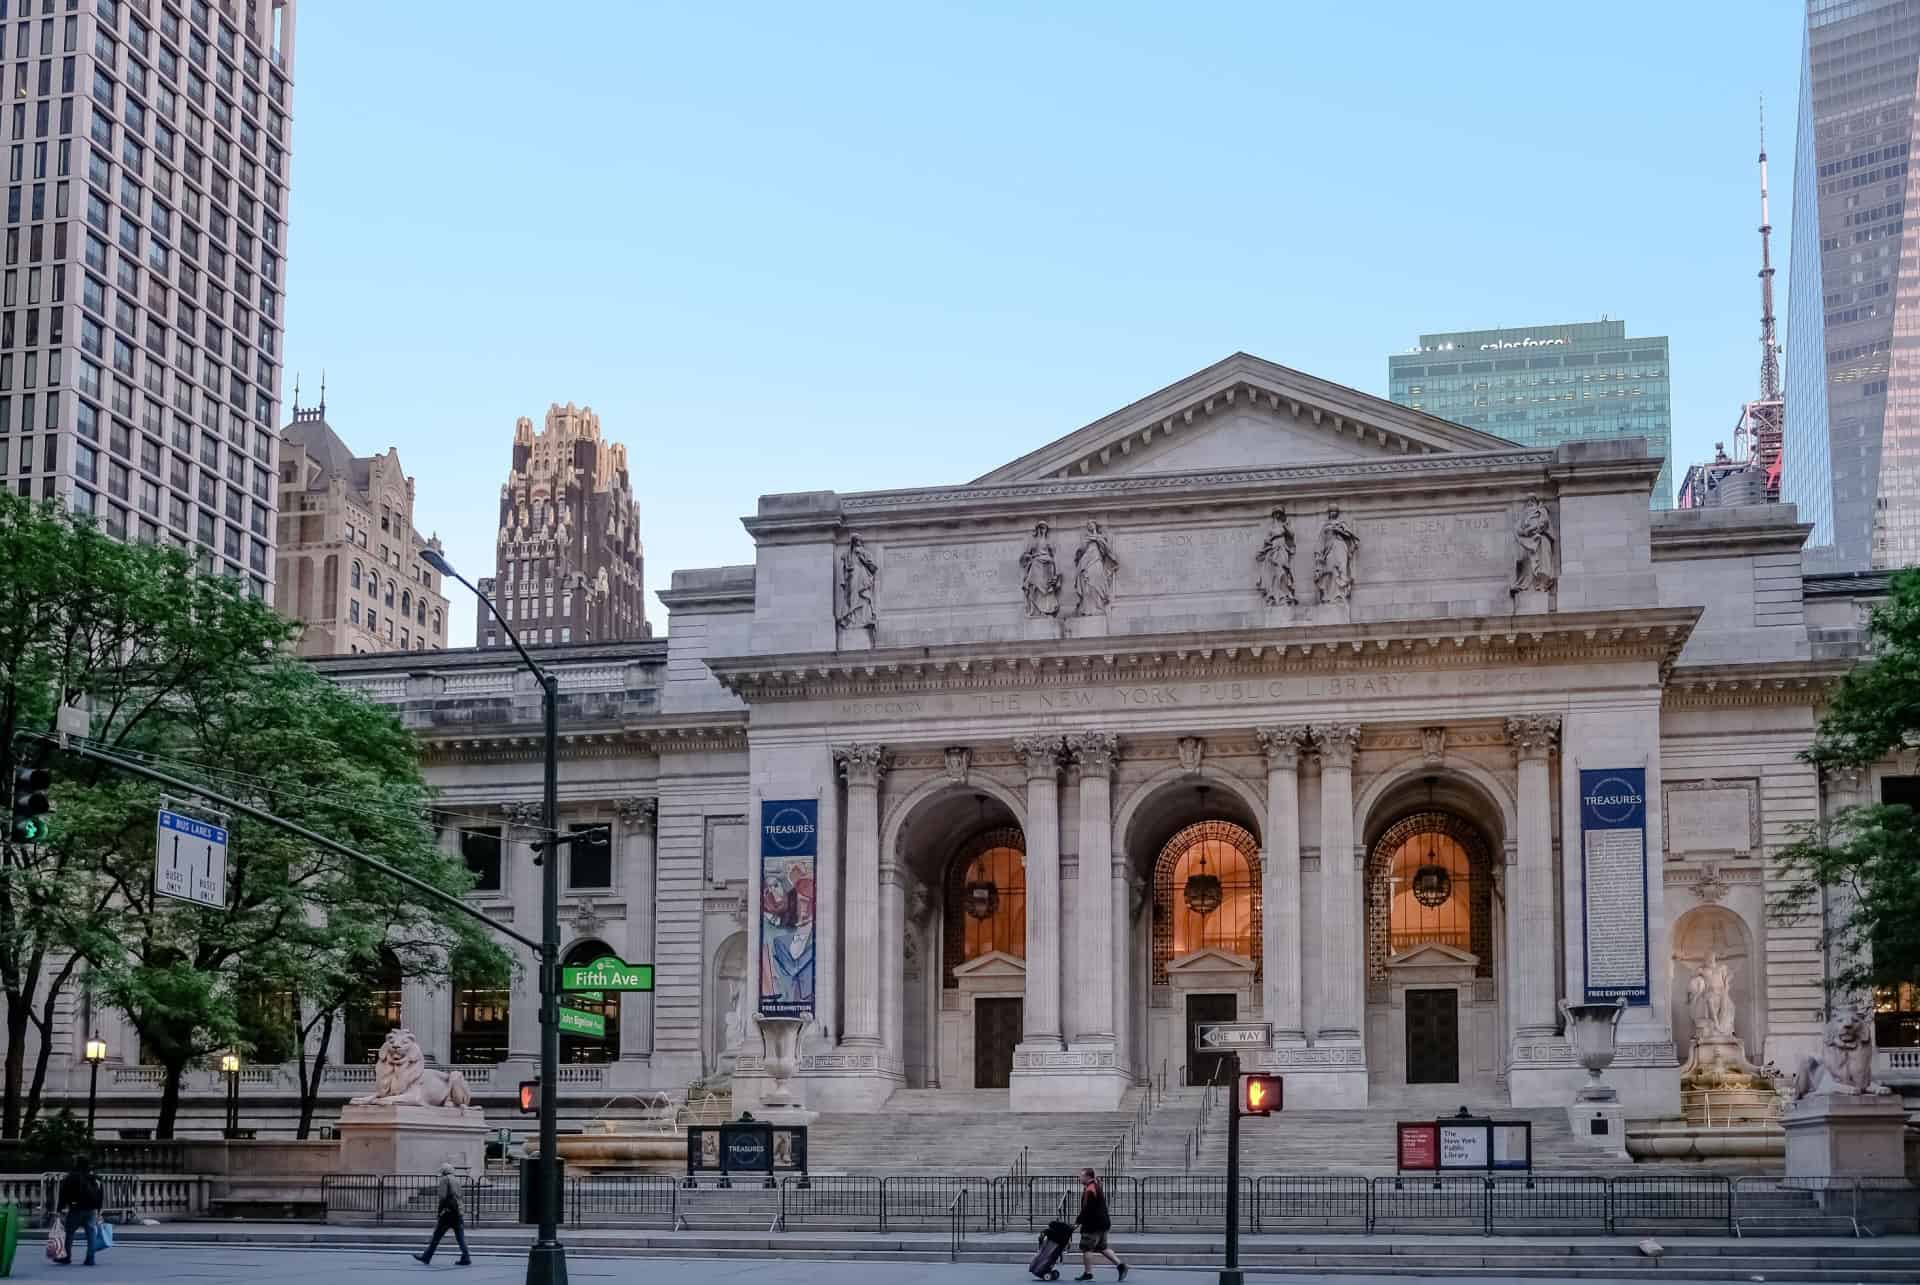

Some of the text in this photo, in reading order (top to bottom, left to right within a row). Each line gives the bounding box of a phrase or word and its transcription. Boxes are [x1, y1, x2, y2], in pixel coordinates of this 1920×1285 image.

[973, 694, 1021, 713] THE
[1039, 690, 1096, 709] NEW
[1117, 687, 1178, 705] YORK
[1200, 681, 1283, 701] PUBLIC
[1306, 673, 1408, 697] LIBRARY
[1584, 795, 1642, 806] TREASURES
[176, 817, 212, 838] BUS LANES
[764, 824, 815, 834] TREASURES
[166, 870, 183, 882] BUSES
[167, 882, 181, 893] ONLY
[200, 879, 216, 890] BUSES
[201, 891, 214, 901] ONLY
[576, 971, 639, 985] Fifth Ave
[1210, 1032, 1260, 1041] ONE WAY
[1444, 1152, 1470, 1160] Library
